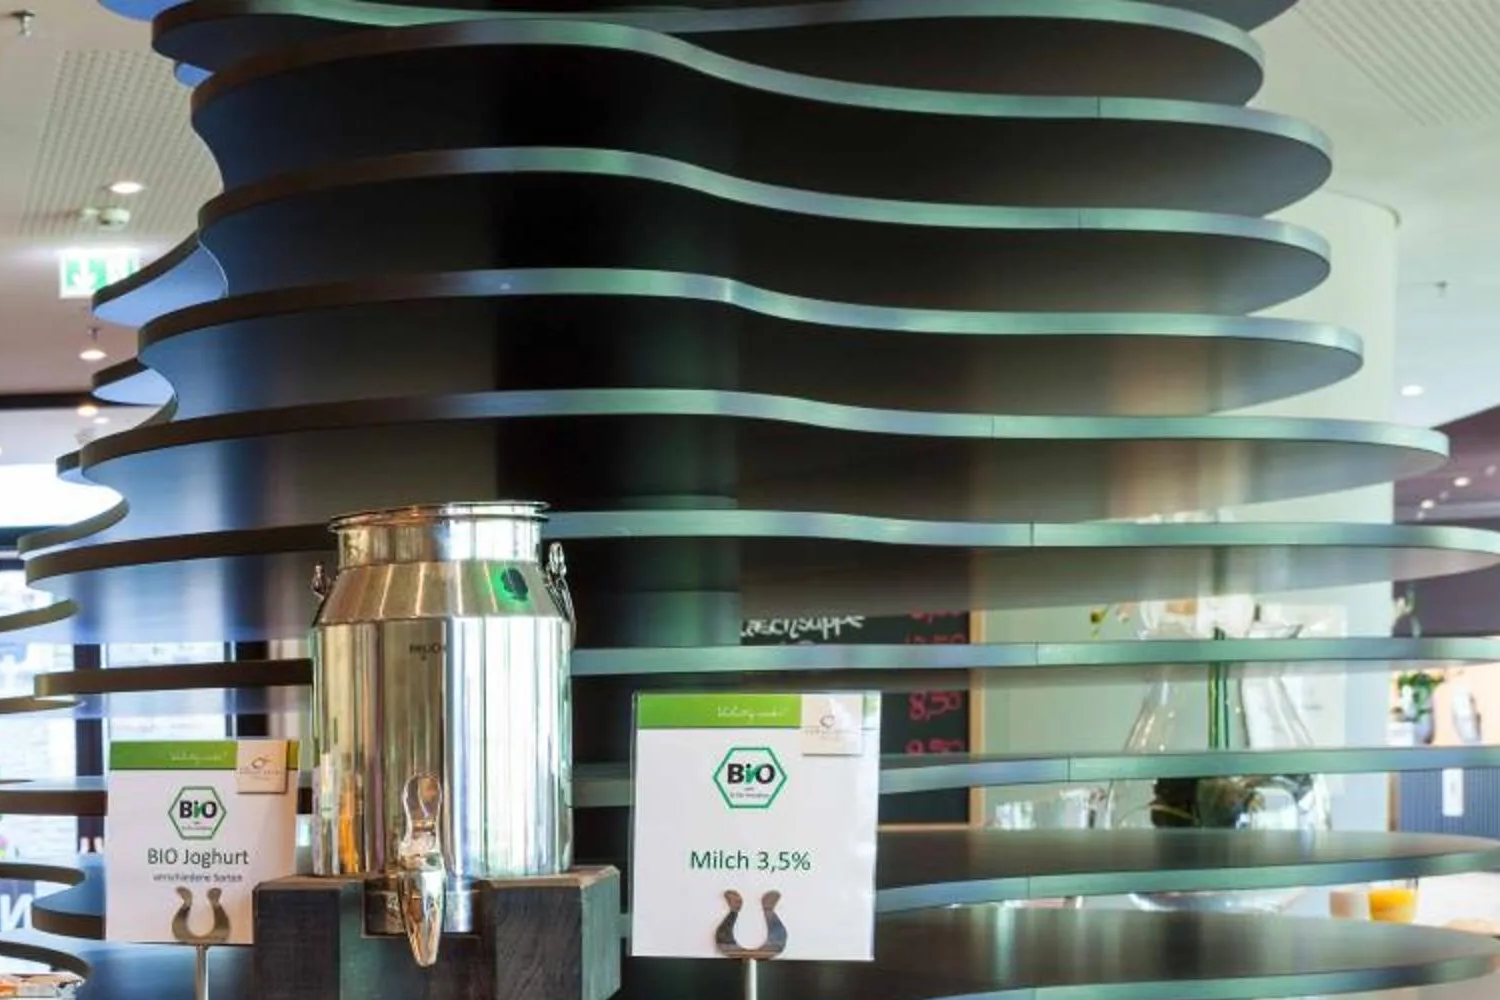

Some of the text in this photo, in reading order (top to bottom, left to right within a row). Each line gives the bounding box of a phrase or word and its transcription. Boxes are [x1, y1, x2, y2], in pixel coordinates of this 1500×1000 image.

[147, 848, 249, 869] BIO Joghurt
[690, 850, 811, 872] Milch 3,5%
